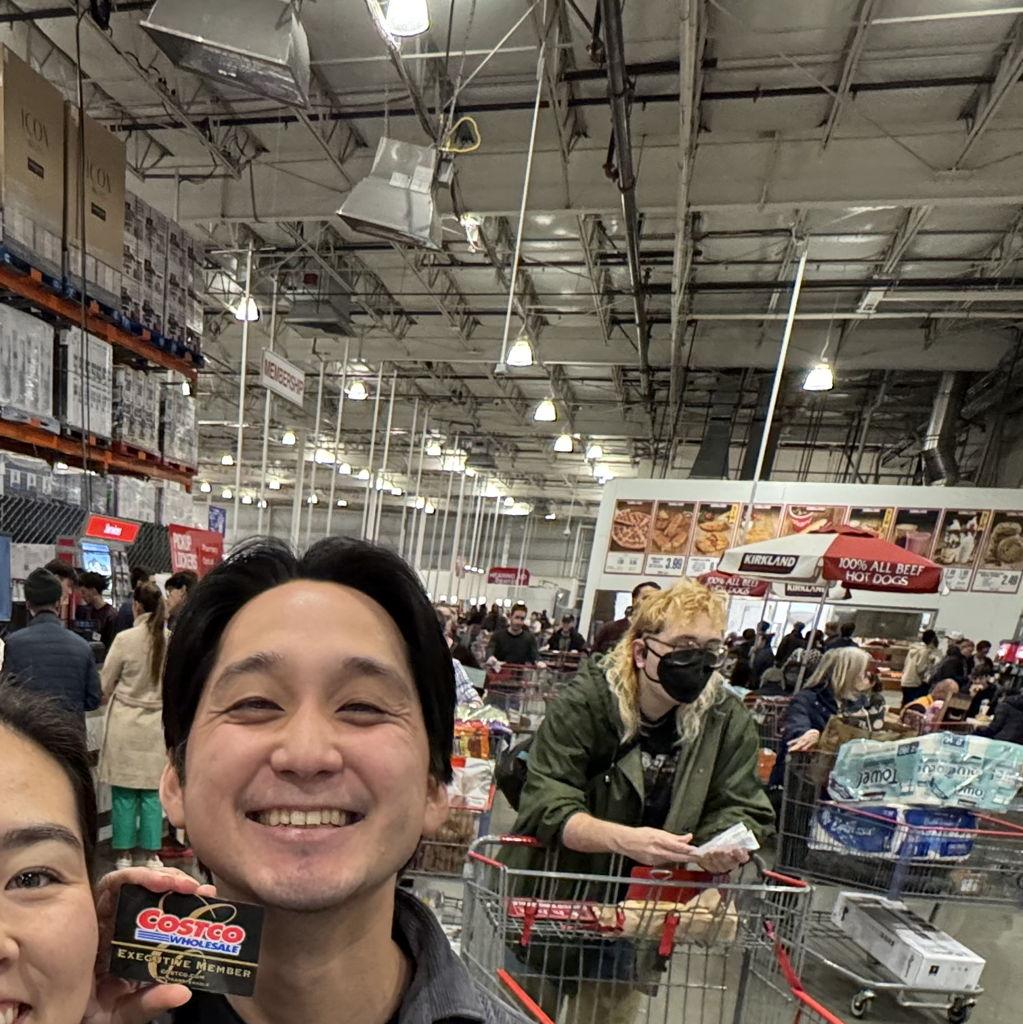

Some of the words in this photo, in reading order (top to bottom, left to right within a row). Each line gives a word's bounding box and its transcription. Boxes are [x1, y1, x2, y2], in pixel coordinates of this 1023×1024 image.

[743, 553, 797, 568] KIRKLAND
[838, 557, 868, 571] 100%
[869, 560, 892, 574] ALL
[895, 562, 925, 577] BEEF
[725, 577, 741, 586] ALL
[845, 570, 872, 583] HOT
[872, 573, 909, 586] DOGS
[137, 908, 245, 944] COSTCO
[169, 934, 240, 954] WHOLESALE
[117, 948, 194, 969] EXECUTIVE
[196, 959, 252, 978] MEMBER
